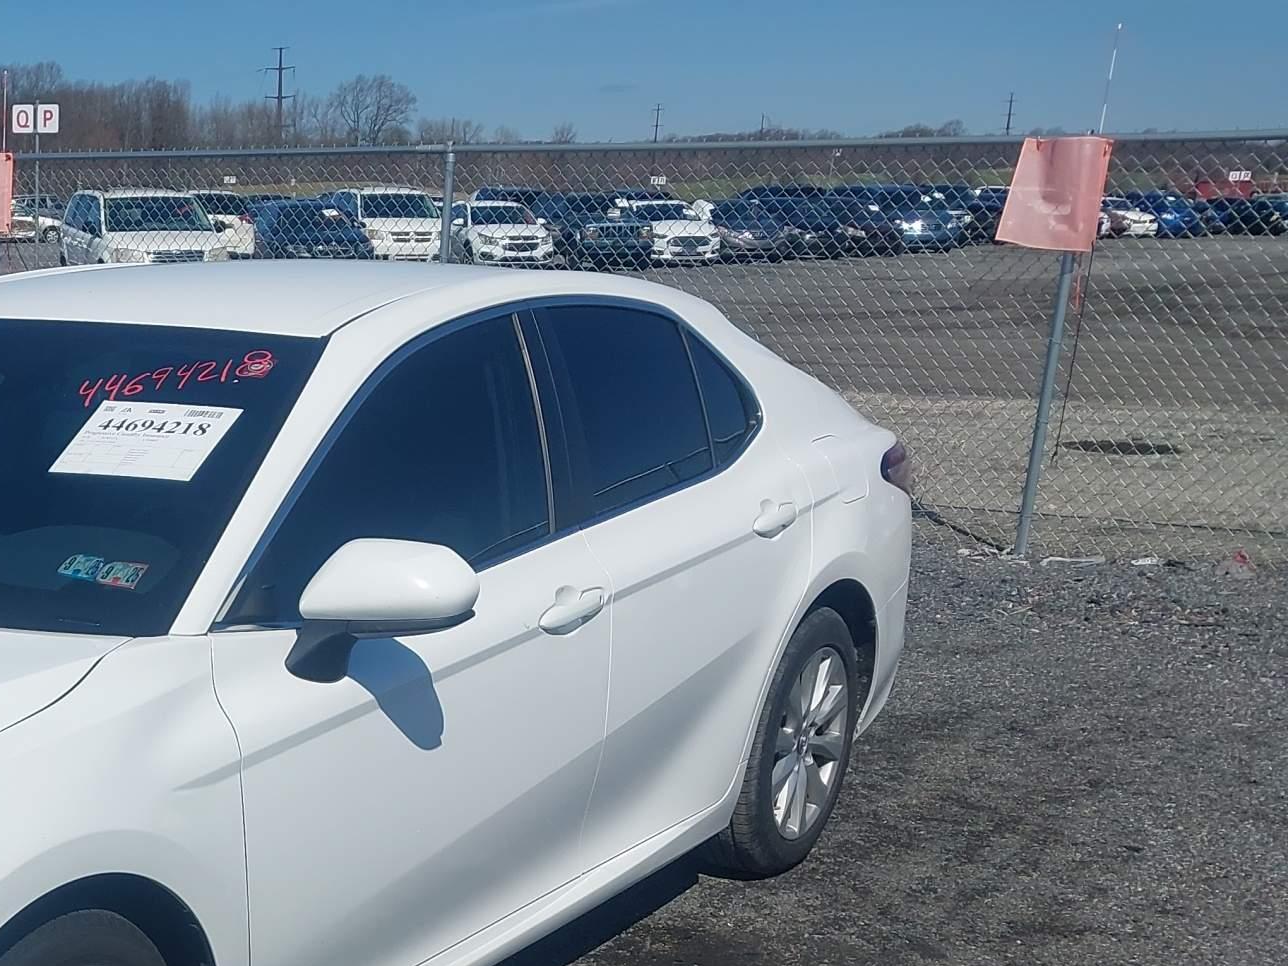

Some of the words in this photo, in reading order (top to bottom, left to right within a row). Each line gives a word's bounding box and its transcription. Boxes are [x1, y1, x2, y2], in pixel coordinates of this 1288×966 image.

[16, 109, 30, 128] Q
[43, 109, 54, 128] P
[98, 418, 212, 437] 44694218
